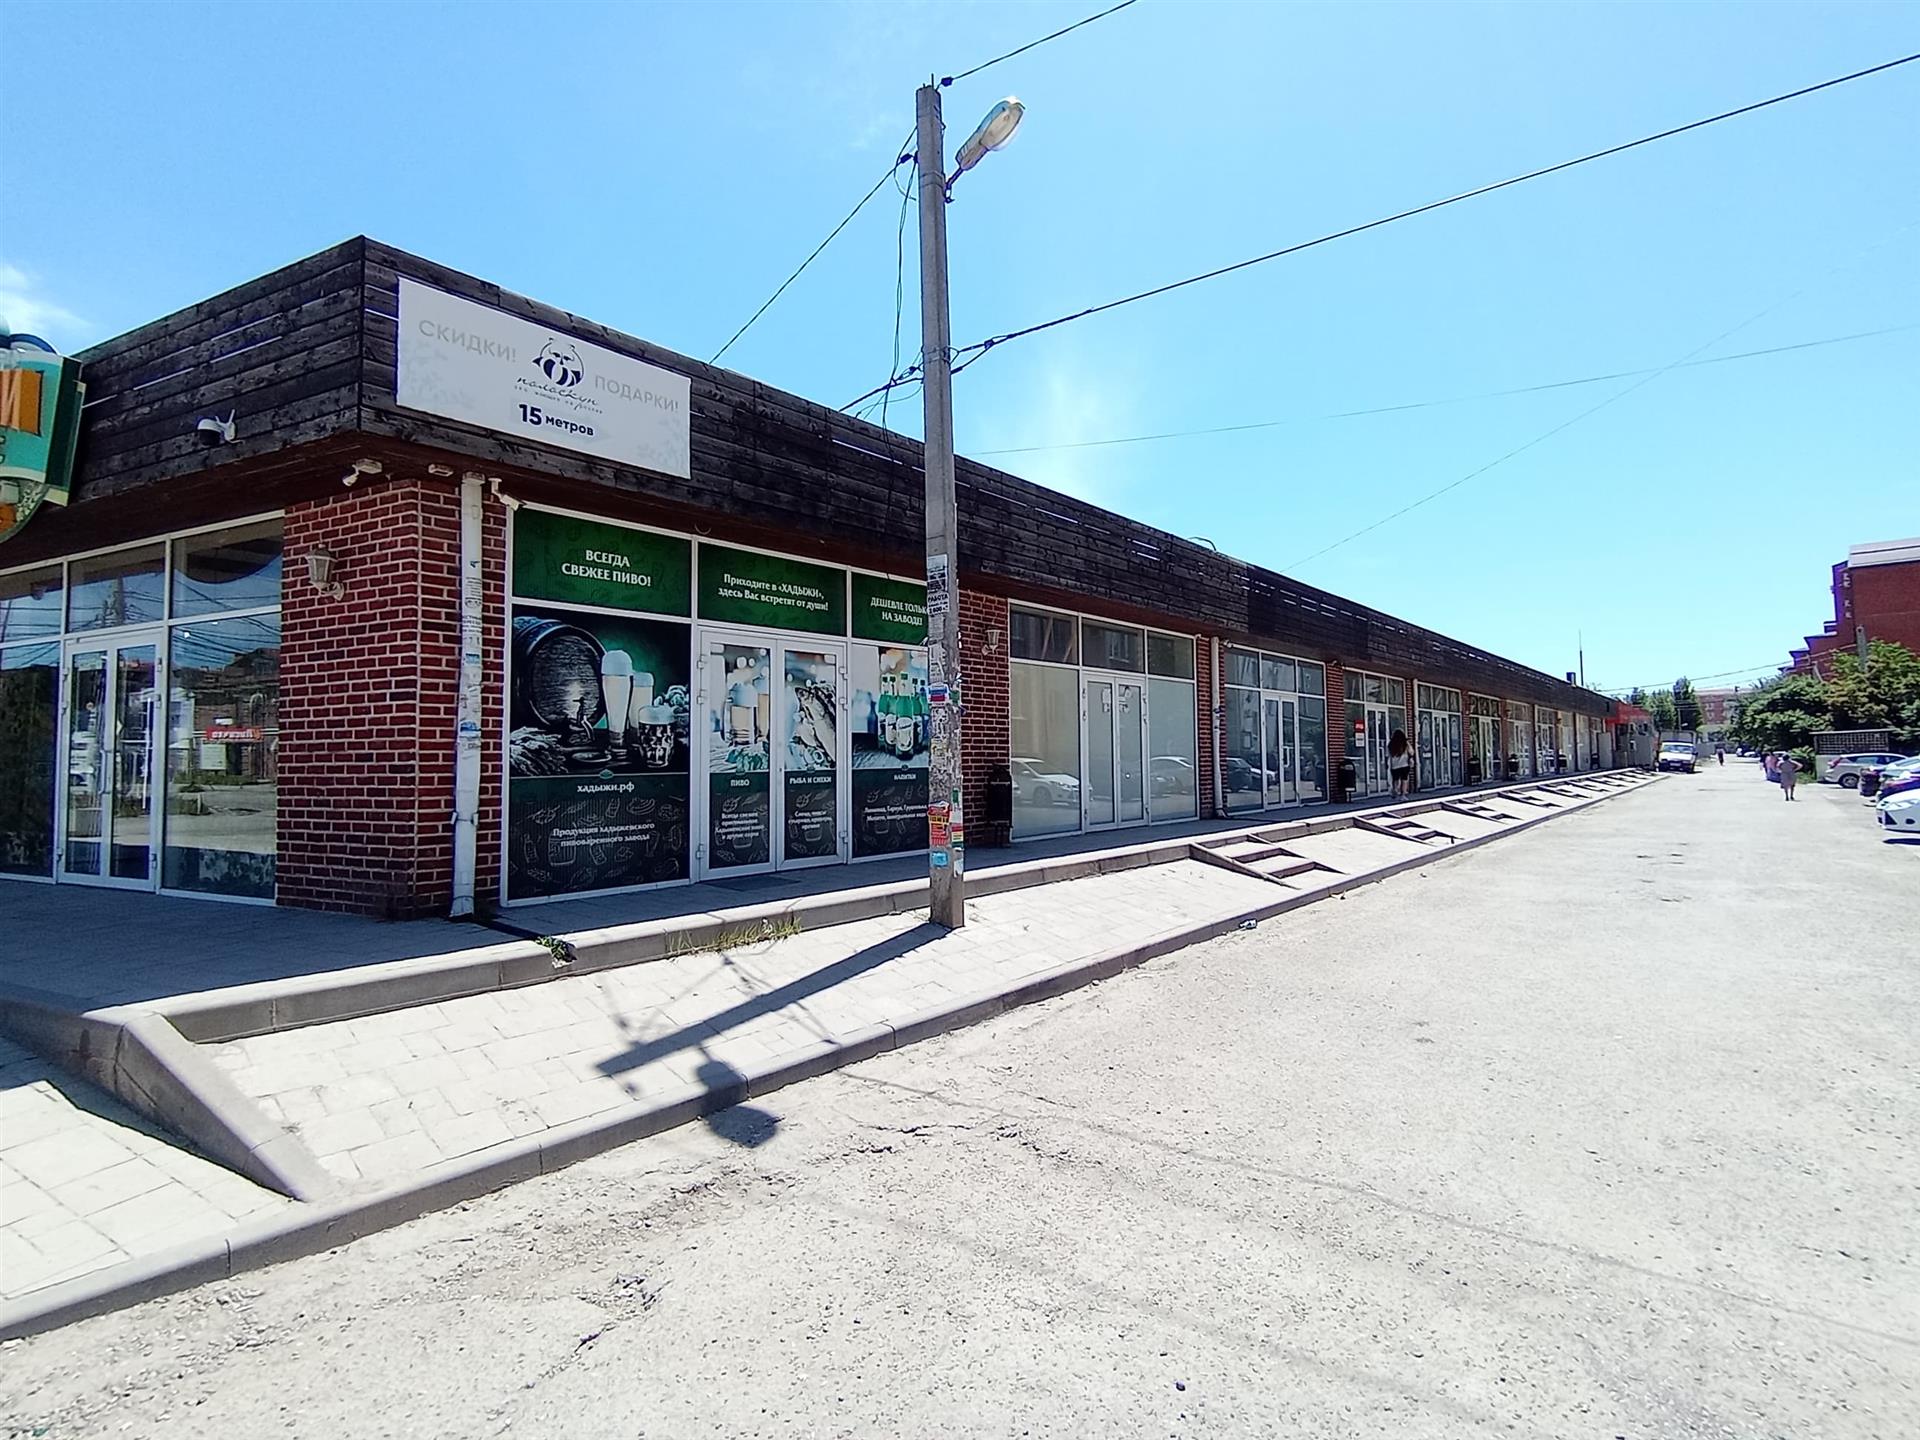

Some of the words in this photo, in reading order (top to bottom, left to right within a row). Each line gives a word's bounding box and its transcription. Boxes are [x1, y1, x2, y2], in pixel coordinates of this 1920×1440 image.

[418, 319, 516, 363] СКИДКИ!
[595, 374, 680, 413] ПОДАРКИ!
[518, 402, 543, 426] 15
[545, 415, 594, 437] метров
[585, 549, 631, 568] ВСЕГДА
[561, 562, 611, 581] СВЕЖЕЕ
[612, 570, 652, 587] ПИВО!
[723, 573, 770, 590] Приходите
[718, 587, 743, 598] здесь
[744, 589, 760, 601] Вас
[760, 593, 795, 606] встретят
[806, 602, 829, 611] души!
[870, 596, 905, 611] ДЕШЕВЛЕ
[904, 602, 928, 615] ТОЛЬК
[881, 610, 893, 621] НА
[576, 780, 636, 794] хадыжи.рф
